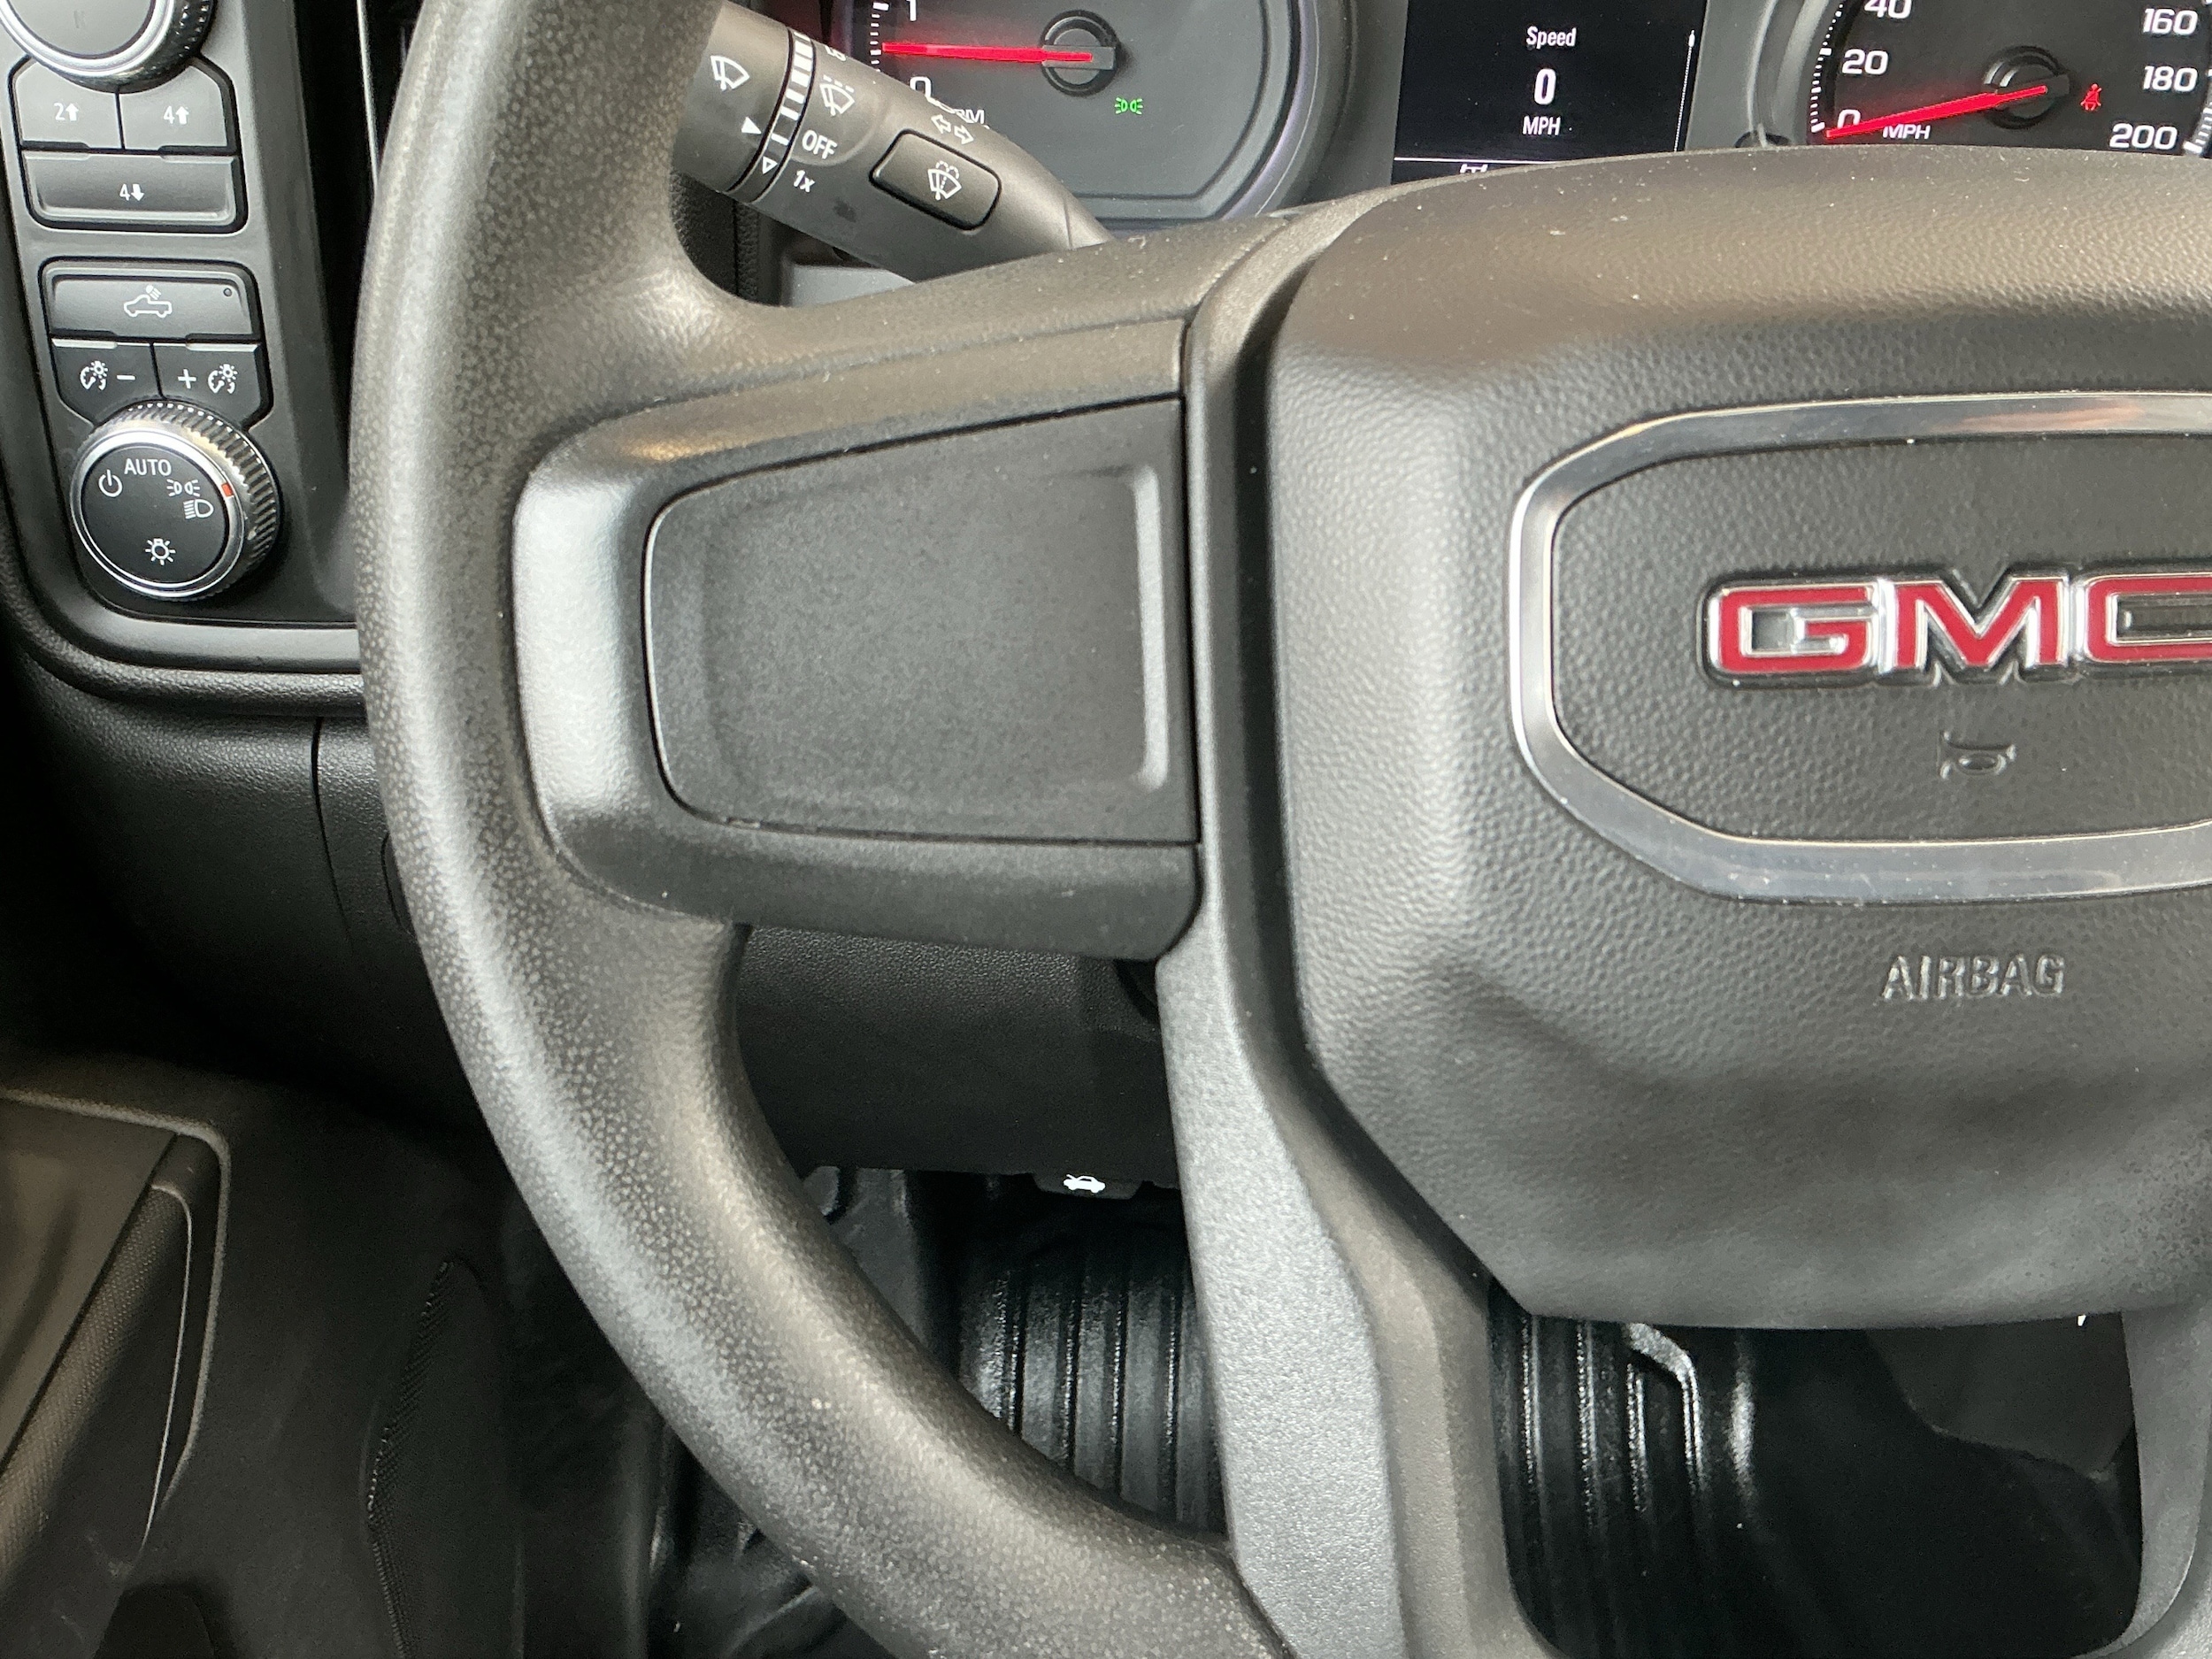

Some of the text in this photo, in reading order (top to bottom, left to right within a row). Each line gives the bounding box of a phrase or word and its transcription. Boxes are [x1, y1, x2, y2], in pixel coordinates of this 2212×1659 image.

[1863, 0, 1912, 19] 40
[2142, 8, 2198, 35] 160
[1526, 26, 1577, 50] Speed
[1841, 49, 1889, 75] 20
[1534, 68, 1556, 105] 0
[2142, 65, 2198, 92] 180
[54, 103, 66, 121] 2
[163, 105, 175, 124] 4
[1837, 109, 1861, 129] 0
[1522, 116, 1561, 135] MPH
[1882, 123, 1931, 140] MPH
[2109, 123, 2177, 150] 200
[802, 129, 838, 159] OFF
[119, 183, 130, 201] 4
[124, 457, 172, 477] AUTO
[1705, 570, 2212, 675] GMC
[1882, 953, 2065, 1002] AIRBAG
